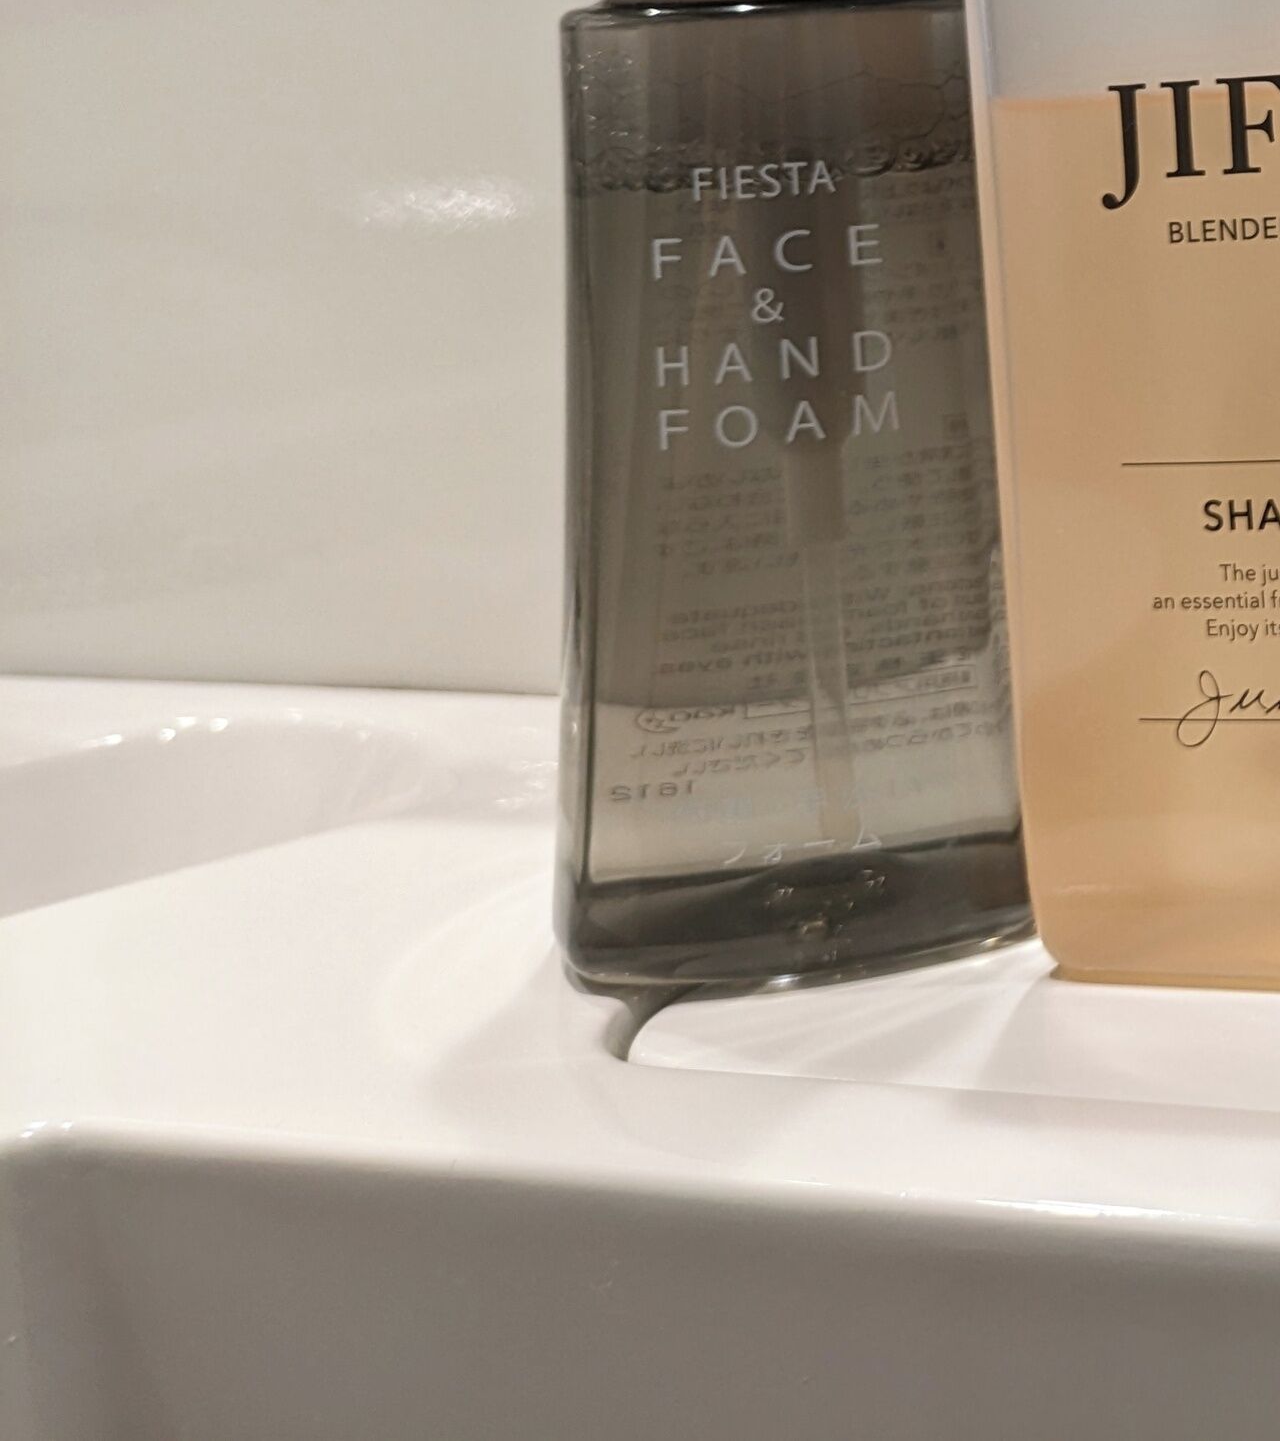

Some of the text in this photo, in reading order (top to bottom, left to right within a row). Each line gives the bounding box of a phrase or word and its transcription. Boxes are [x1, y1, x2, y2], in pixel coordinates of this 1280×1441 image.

[692, 160, 840, 201] FIESTA
[652, 224, 882, 279] FACE
[752, 288, 784, 323] &
[657, 331, 890, 387] HAND
[659, 392, 898, 450] FOAM
[1219, 563, 1256, 582] The
[1152, 597, 1175, 609] an
[1181, 590, 1265, 610] essential
[1206, 619, 1259, 642] Enjoy
